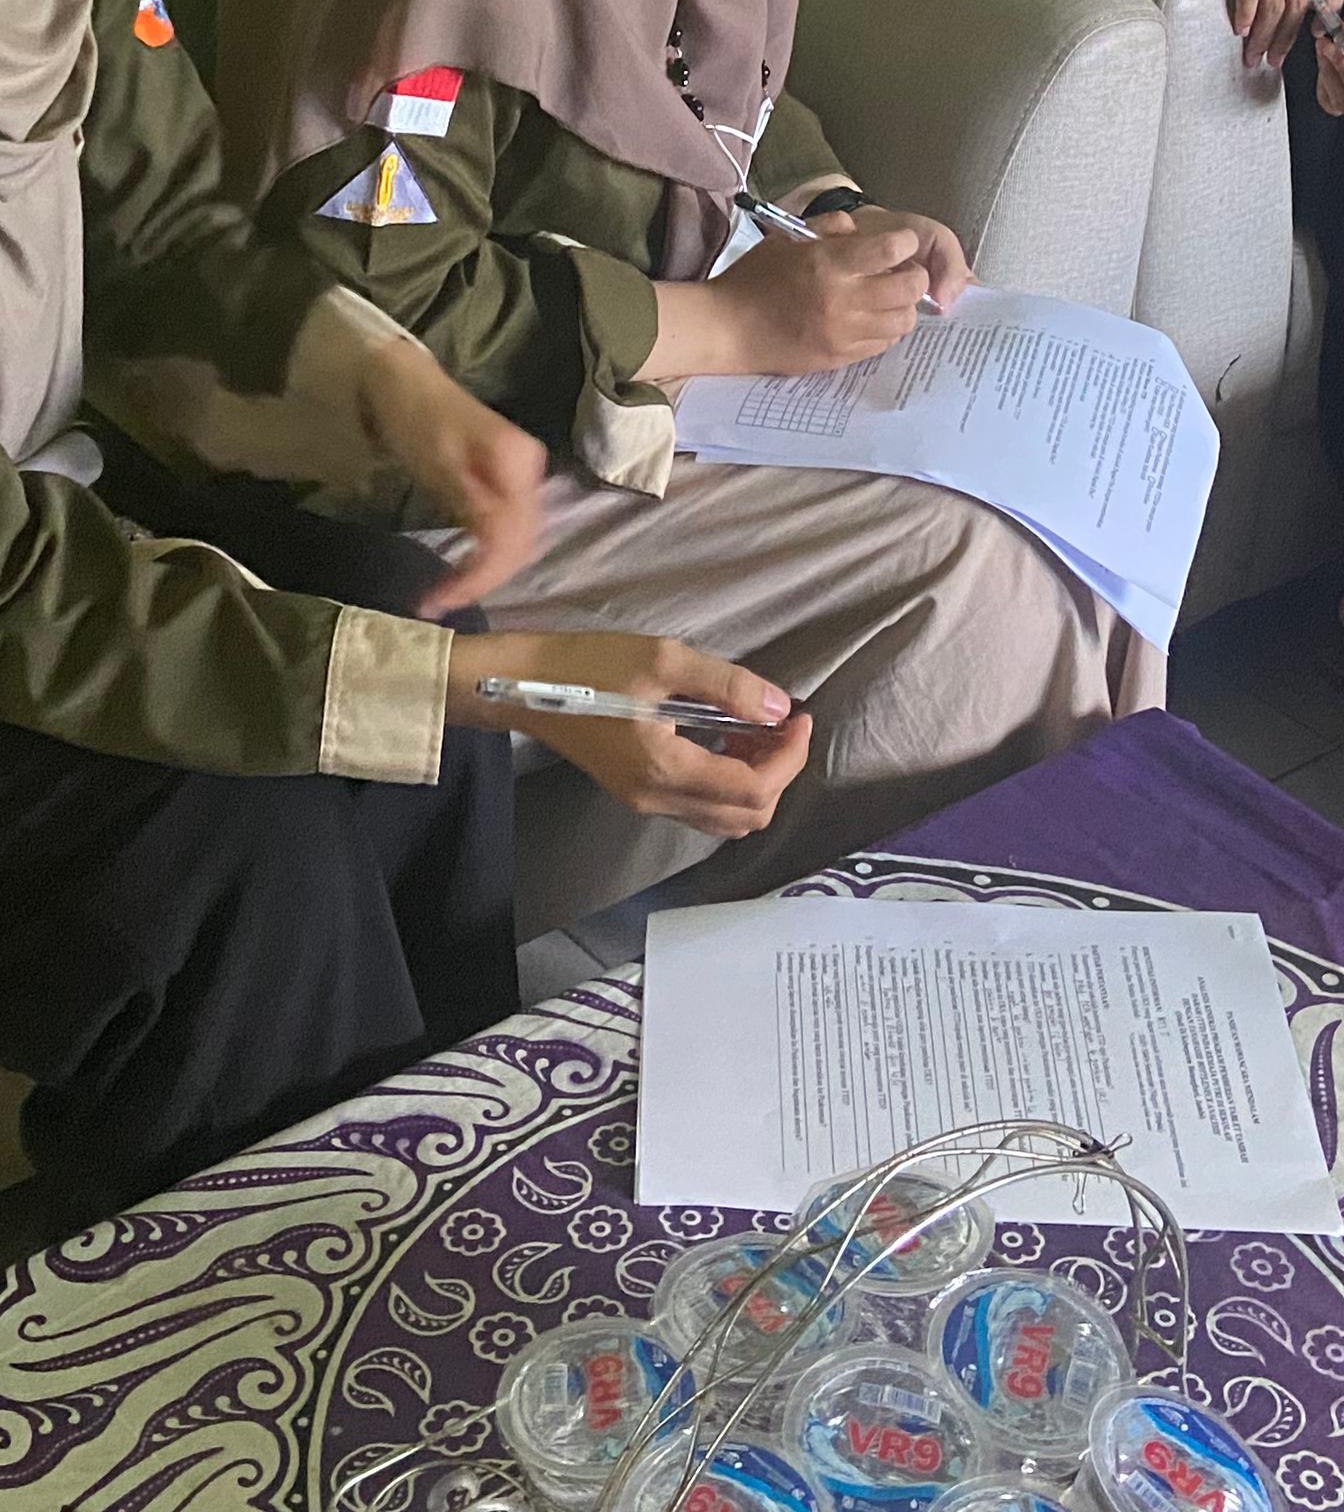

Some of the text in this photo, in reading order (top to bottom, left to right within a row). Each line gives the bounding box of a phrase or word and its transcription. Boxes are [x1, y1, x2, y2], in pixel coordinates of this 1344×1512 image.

[585, 1352, 624, 1432] VR9
[1006, 1324, 1057, 1399] VR9
[847, 1419, 943, 1473] VR9
[1142, 1441, 1226, 1512] VR9
